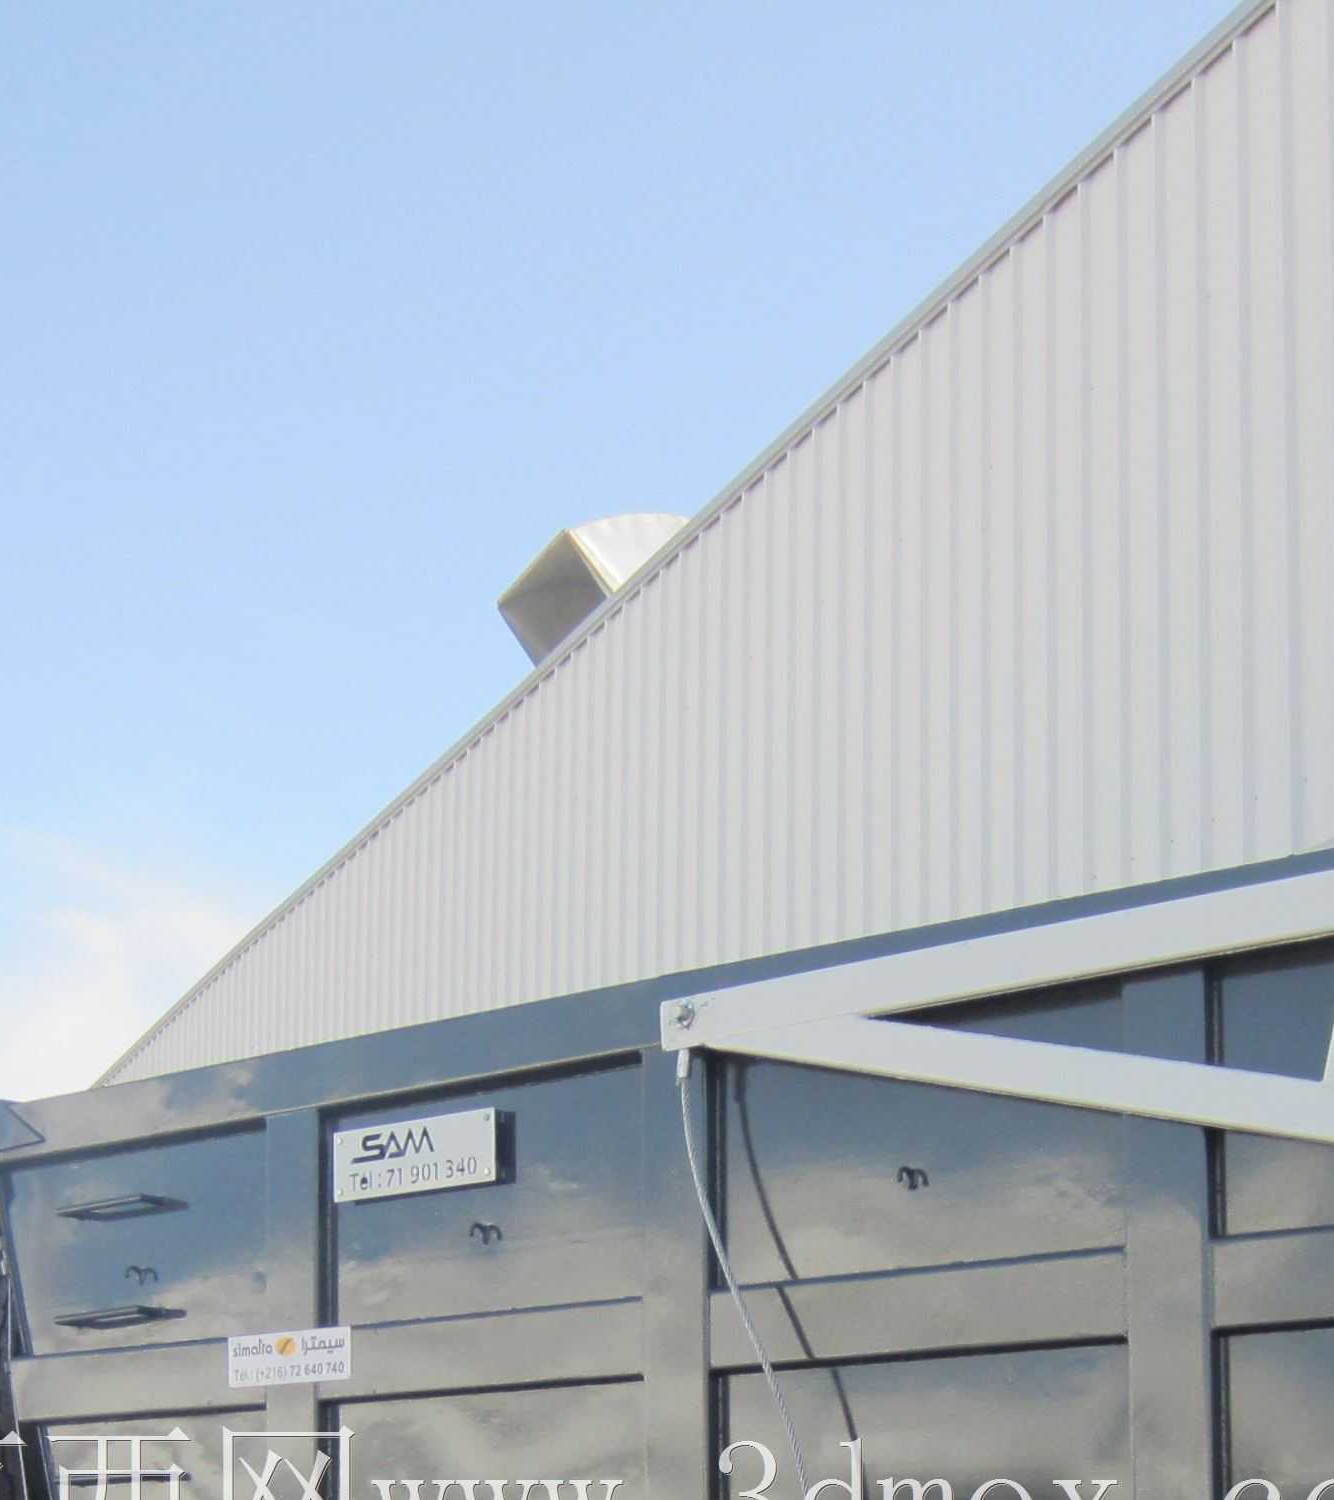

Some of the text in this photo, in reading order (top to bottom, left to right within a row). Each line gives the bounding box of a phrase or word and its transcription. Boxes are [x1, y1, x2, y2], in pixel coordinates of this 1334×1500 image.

[350, 1126, 436, 1164] SAM
[410, 1162, 440, 1184] 901
[445, 1156, 477, 1178] 340
[304, 1362, 324, 1376] 640
[326, 1360, 346, 1375] 740
